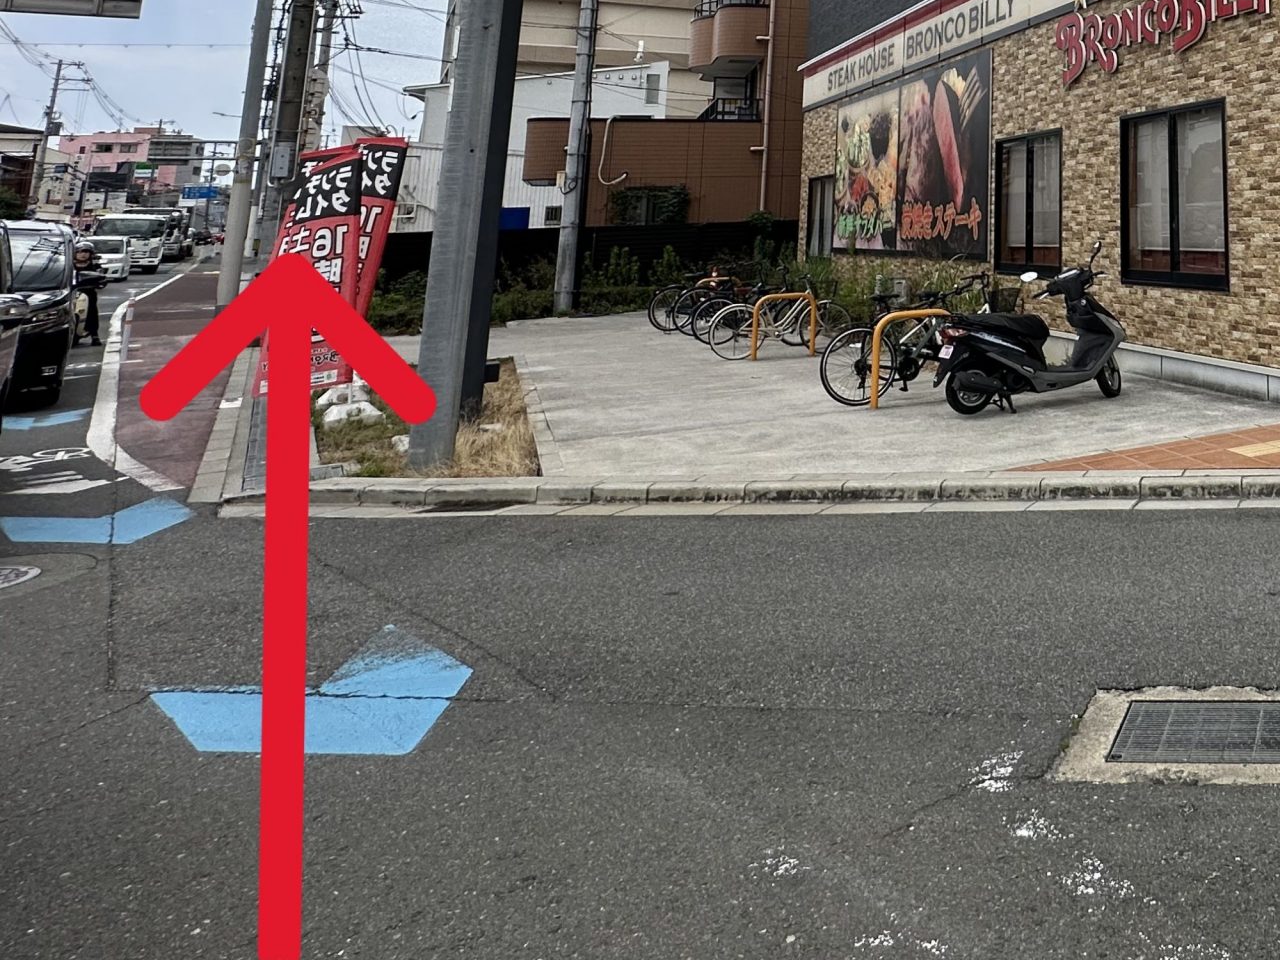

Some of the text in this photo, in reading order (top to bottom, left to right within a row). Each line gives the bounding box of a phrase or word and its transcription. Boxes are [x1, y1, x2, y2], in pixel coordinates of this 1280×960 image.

[827, 65, 857, 92] STEAK
[858, 42, 896, 77] HOUSE
[905, 11, 966, 61] BRONCO
[901, 197, 982, 240] 炭焼きステーキ
